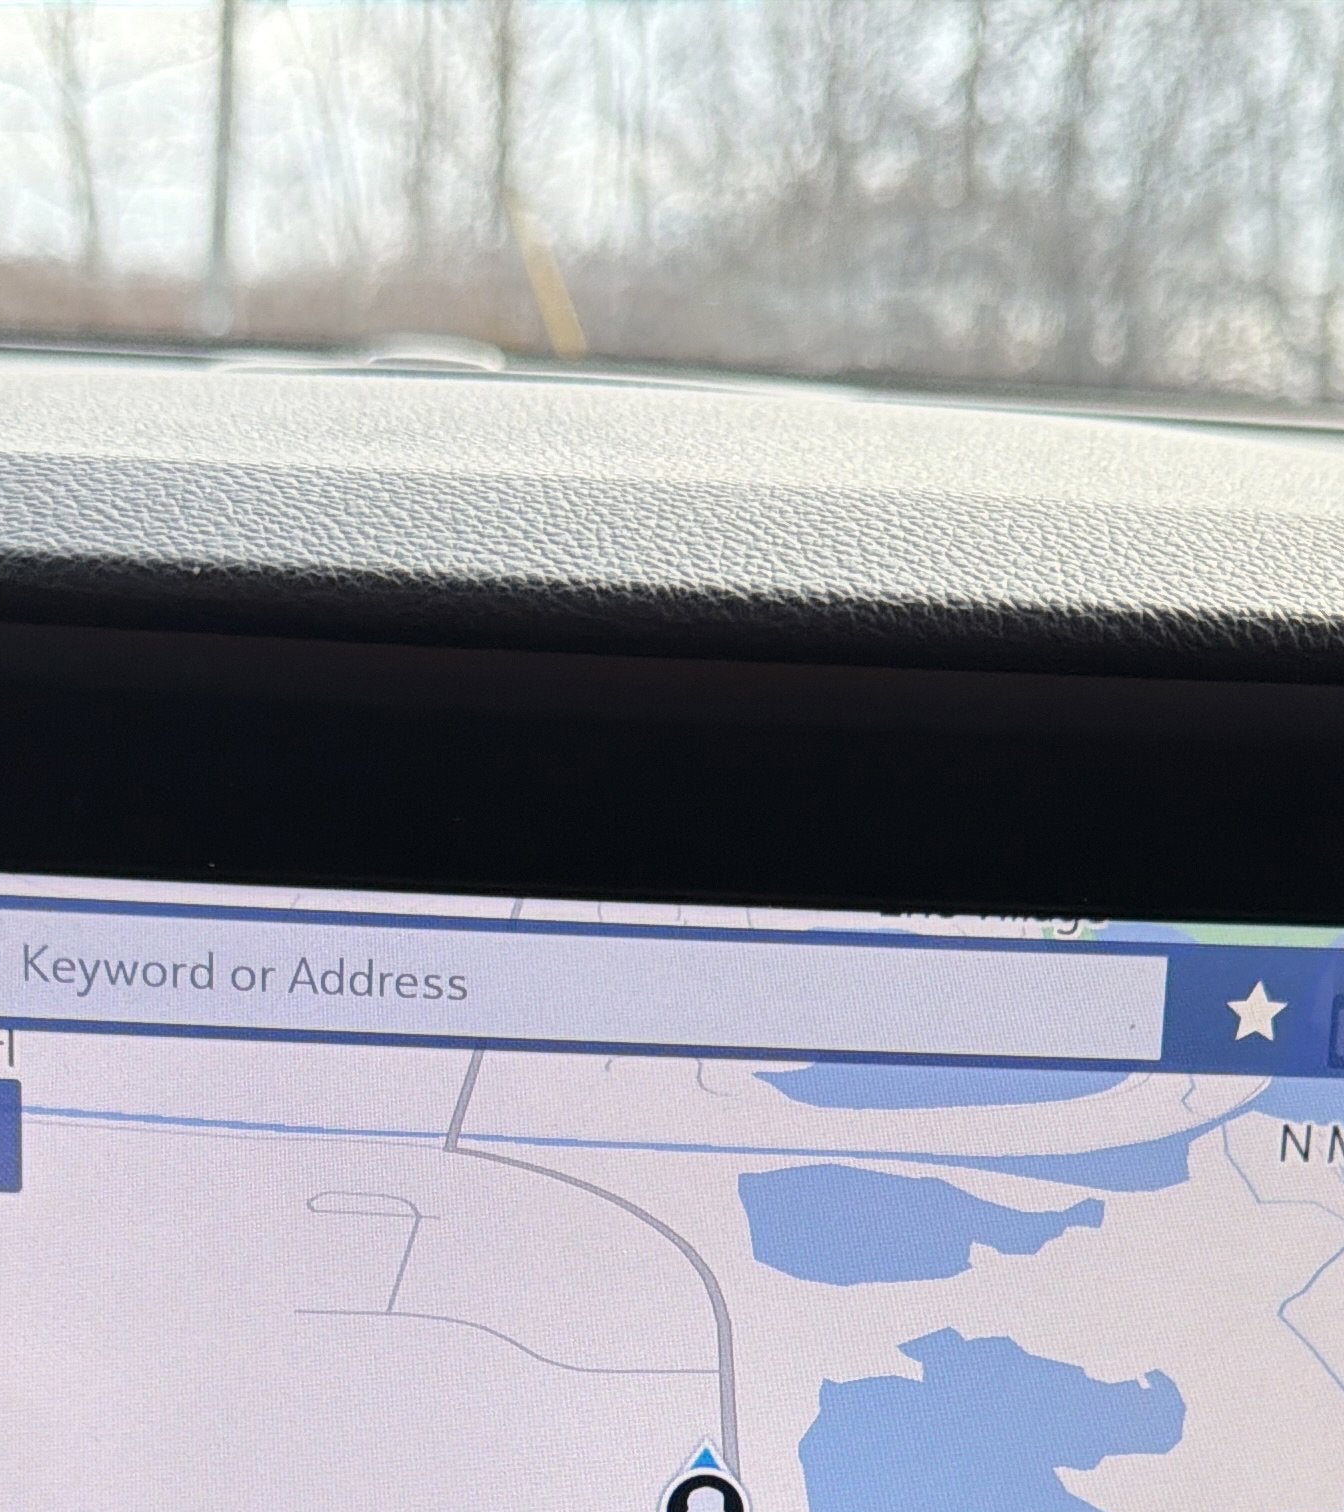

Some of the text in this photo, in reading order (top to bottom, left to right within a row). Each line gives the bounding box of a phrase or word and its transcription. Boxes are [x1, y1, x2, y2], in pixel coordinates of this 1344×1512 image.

[23, 943, 469, 1001] Keyword or Address
[1279, 1123, 1312, 1163] N
